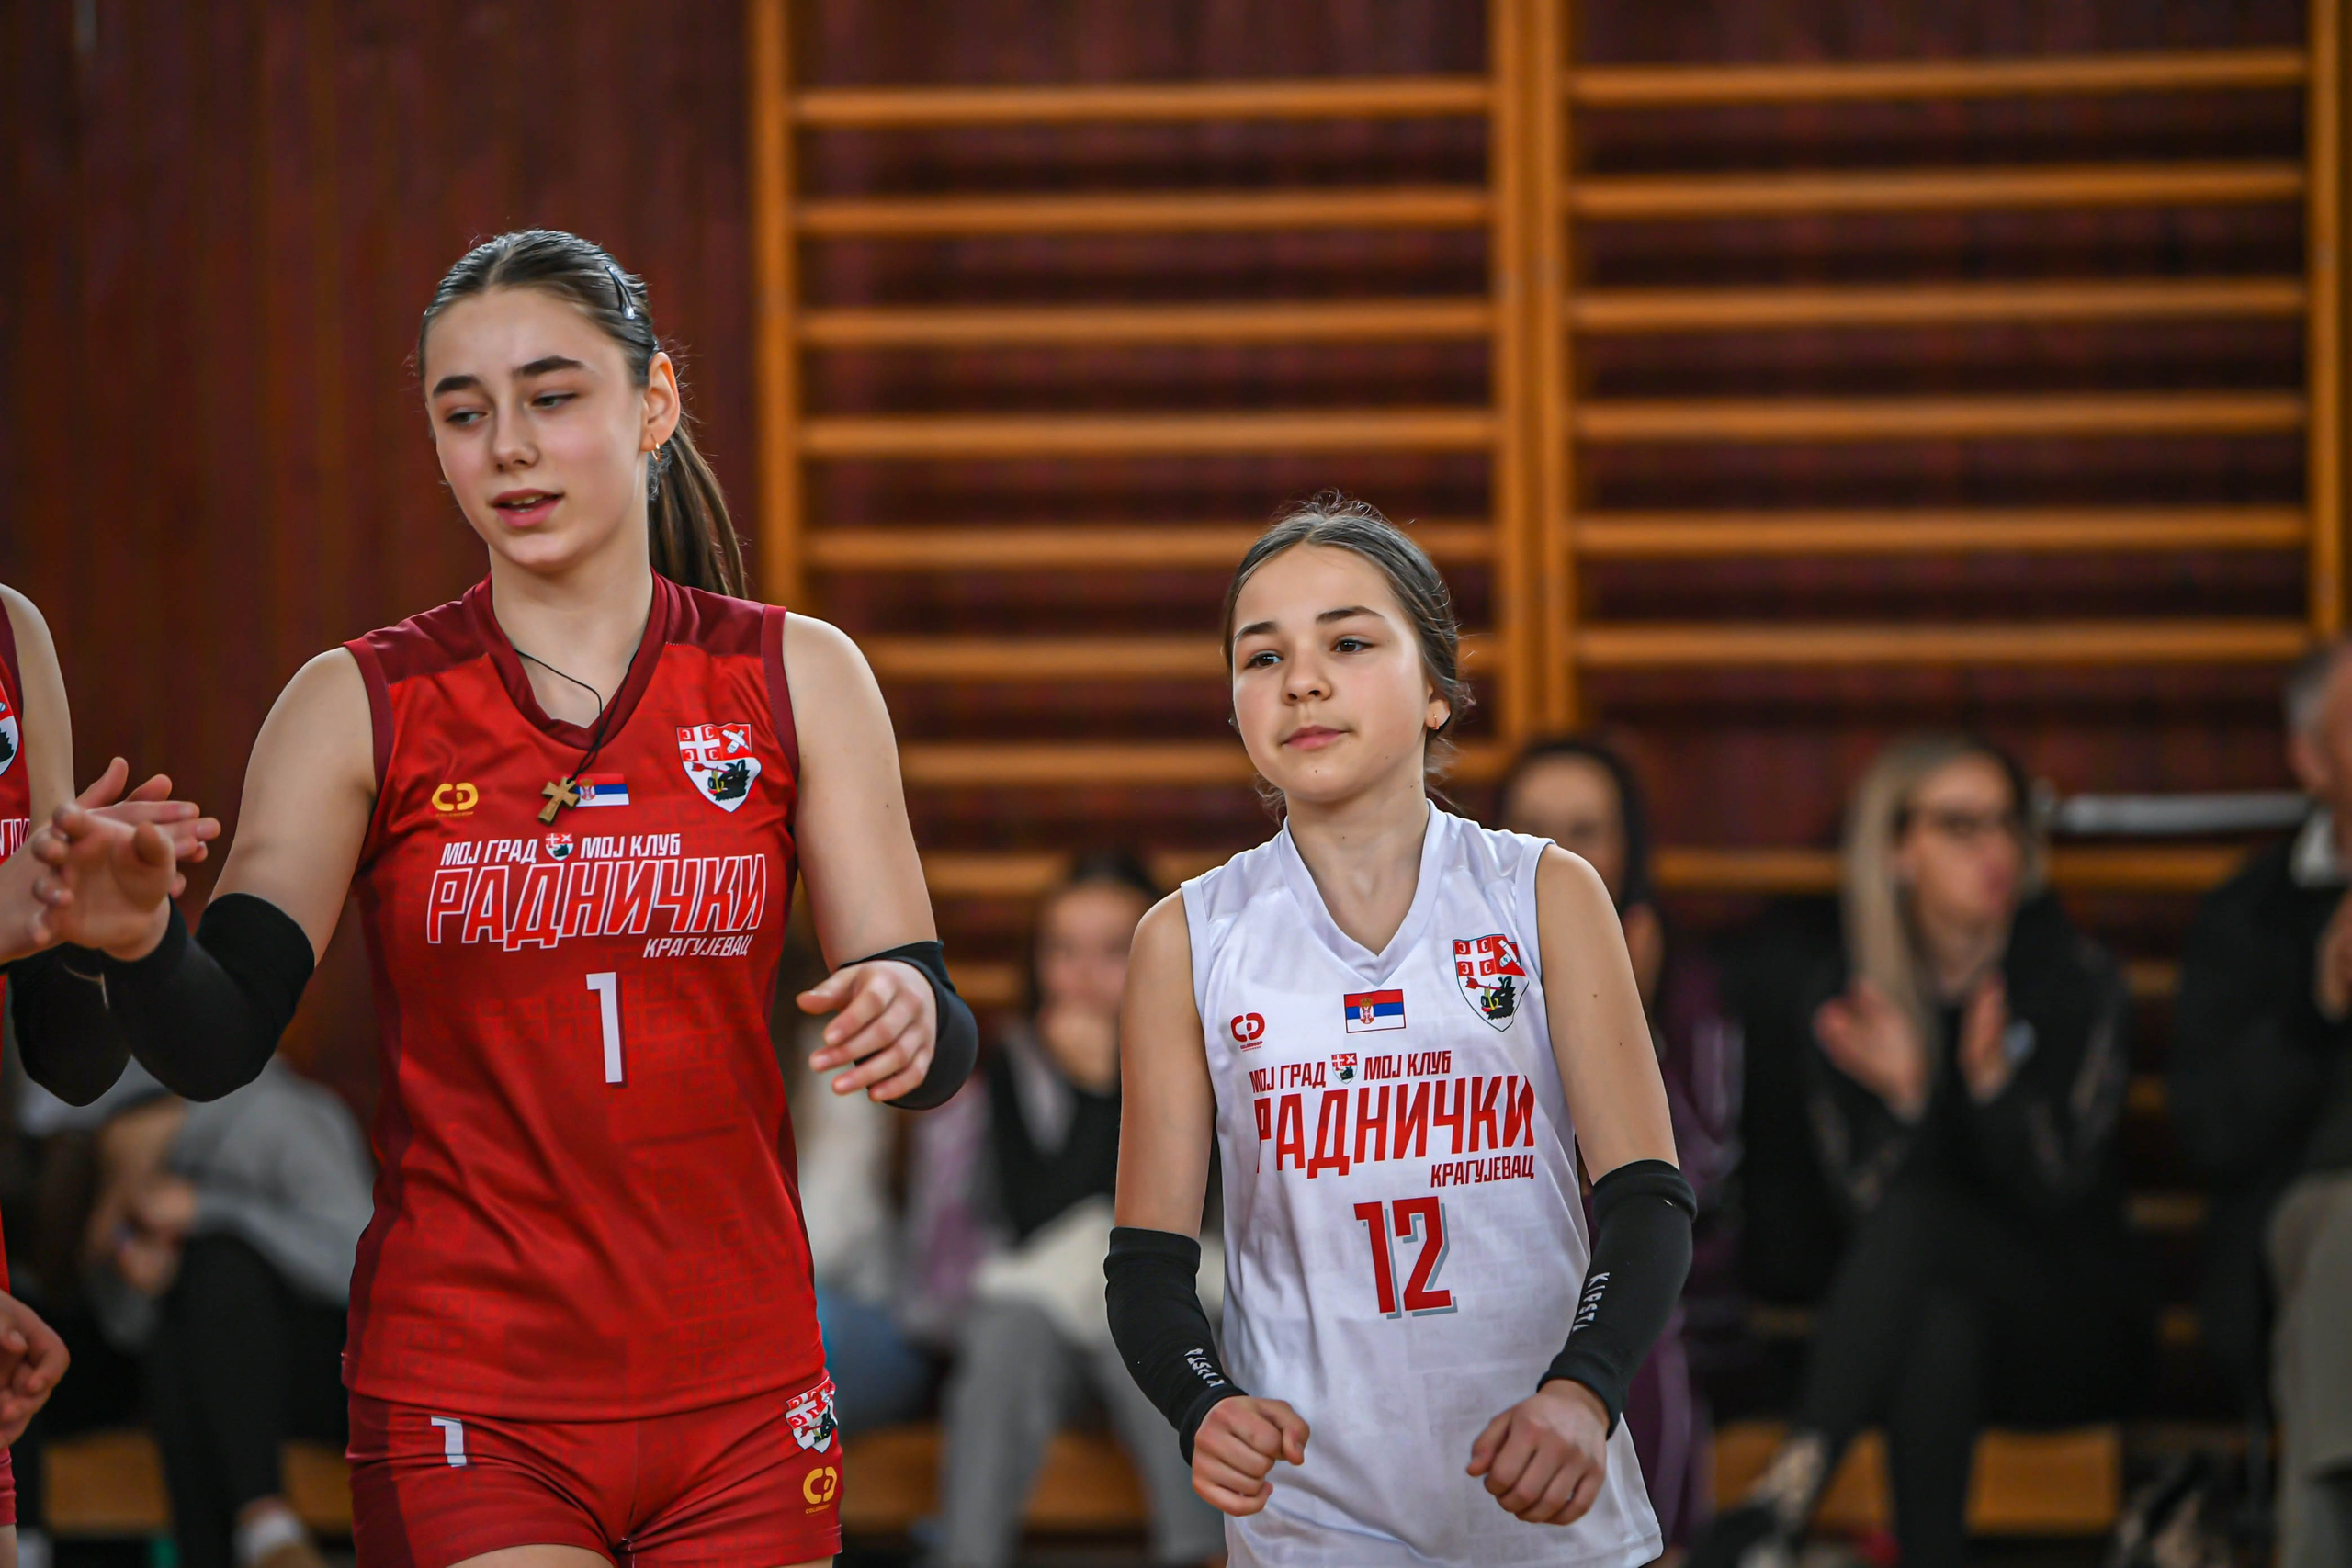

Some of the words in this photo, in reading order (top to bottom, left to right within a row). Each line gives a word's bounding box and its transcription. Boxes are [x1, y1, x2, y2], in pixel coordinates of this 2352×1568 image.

[440, 841, 481, 866] МОЈ
[483, 838, 538, 864] ГРАД
[580, 836, 626, 859] МОЈ
[629, 833, 681, 857] КЛУБ
[426, 853, 767, 953] РАДНИЧКИ
[642, 935, 753, 958] КРАГУЈЕВАЦ
[586, 971, 626, 1085] 1
[1249, 1066, 1275, 1093] МОЈ
[1280, 1061, 1327, 1089] ГРАД
[1363, 1055, 1402, 1081] МОЈ
[1407, 1050, 1452, 1077] КЛУБ
[1253, 1074, 1535, 1179] РАДНИЧКИ
[1430, 1154, 1535, 1188] КРАГУЈЕВАЦ
[1353, 1195, 1455, 1316] 12
[430, 1415, 468, 1467] 1
